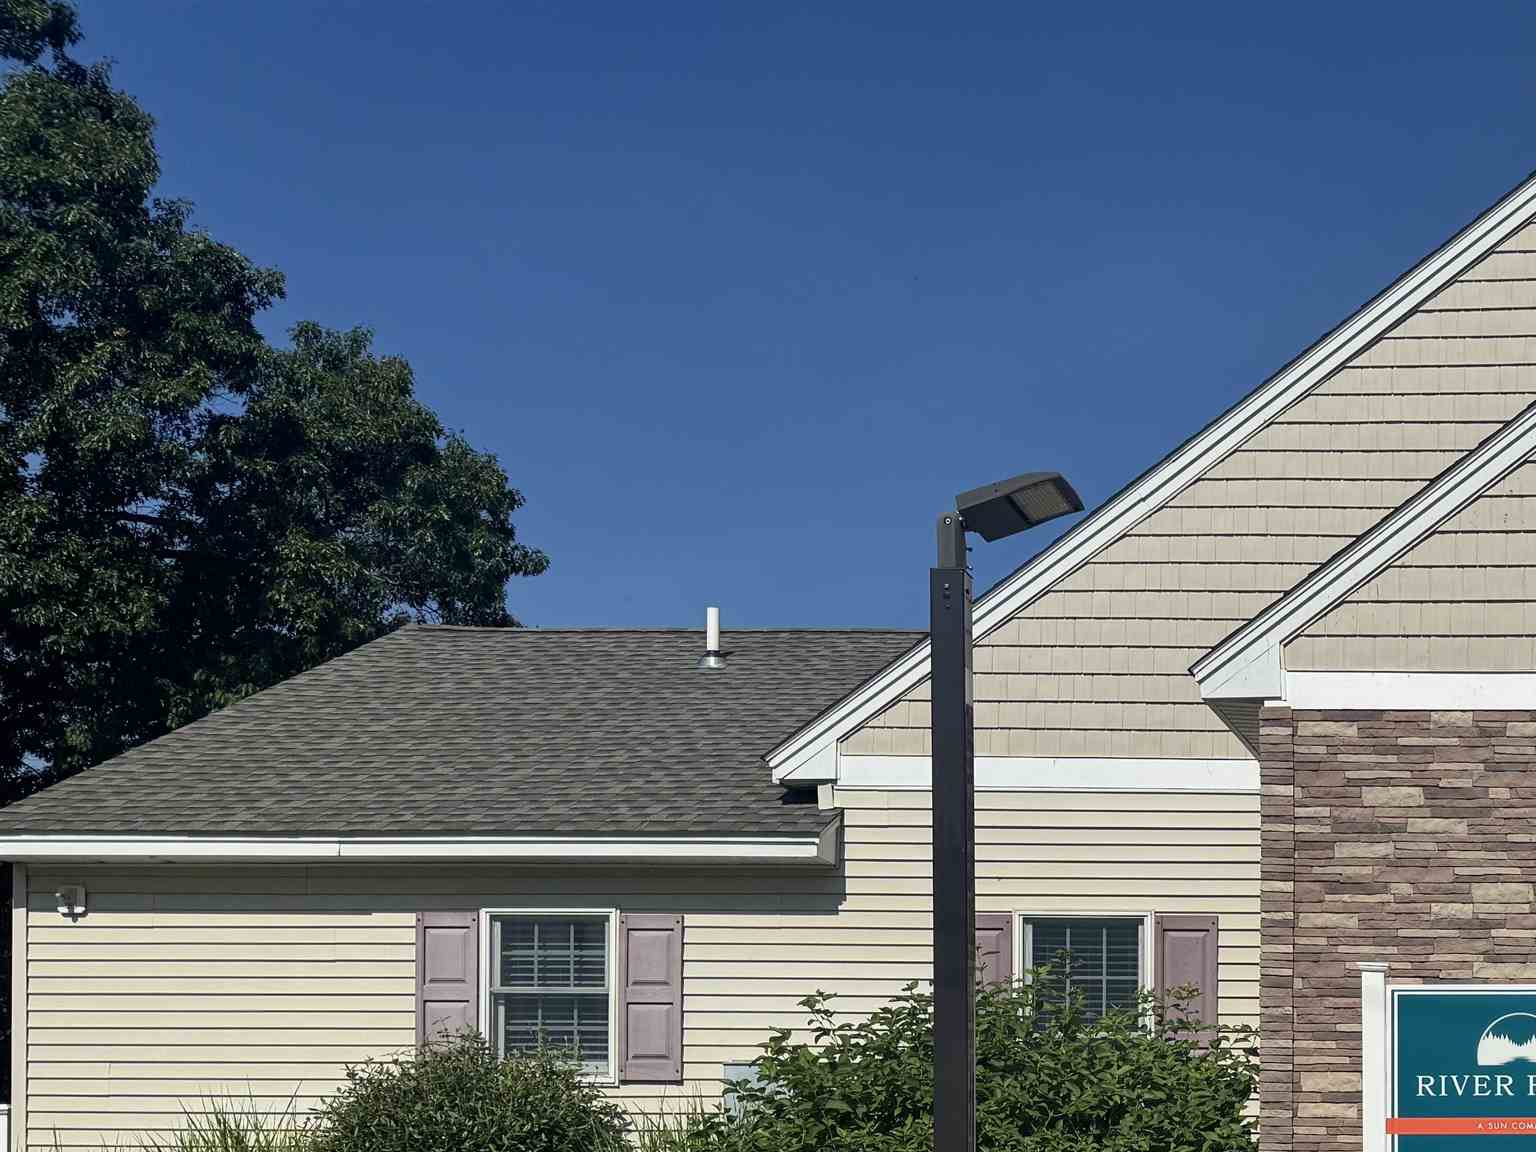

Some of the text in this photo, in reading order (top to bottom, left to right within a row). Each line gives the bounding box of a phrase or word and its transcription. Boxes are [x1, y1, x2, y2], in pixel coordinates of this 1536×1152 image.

[1416, 1074, 1514, 1097] RIVER
[1477, 1122, 1484, 1130] A
[1488, 1122, 1508, 1130] SUN
